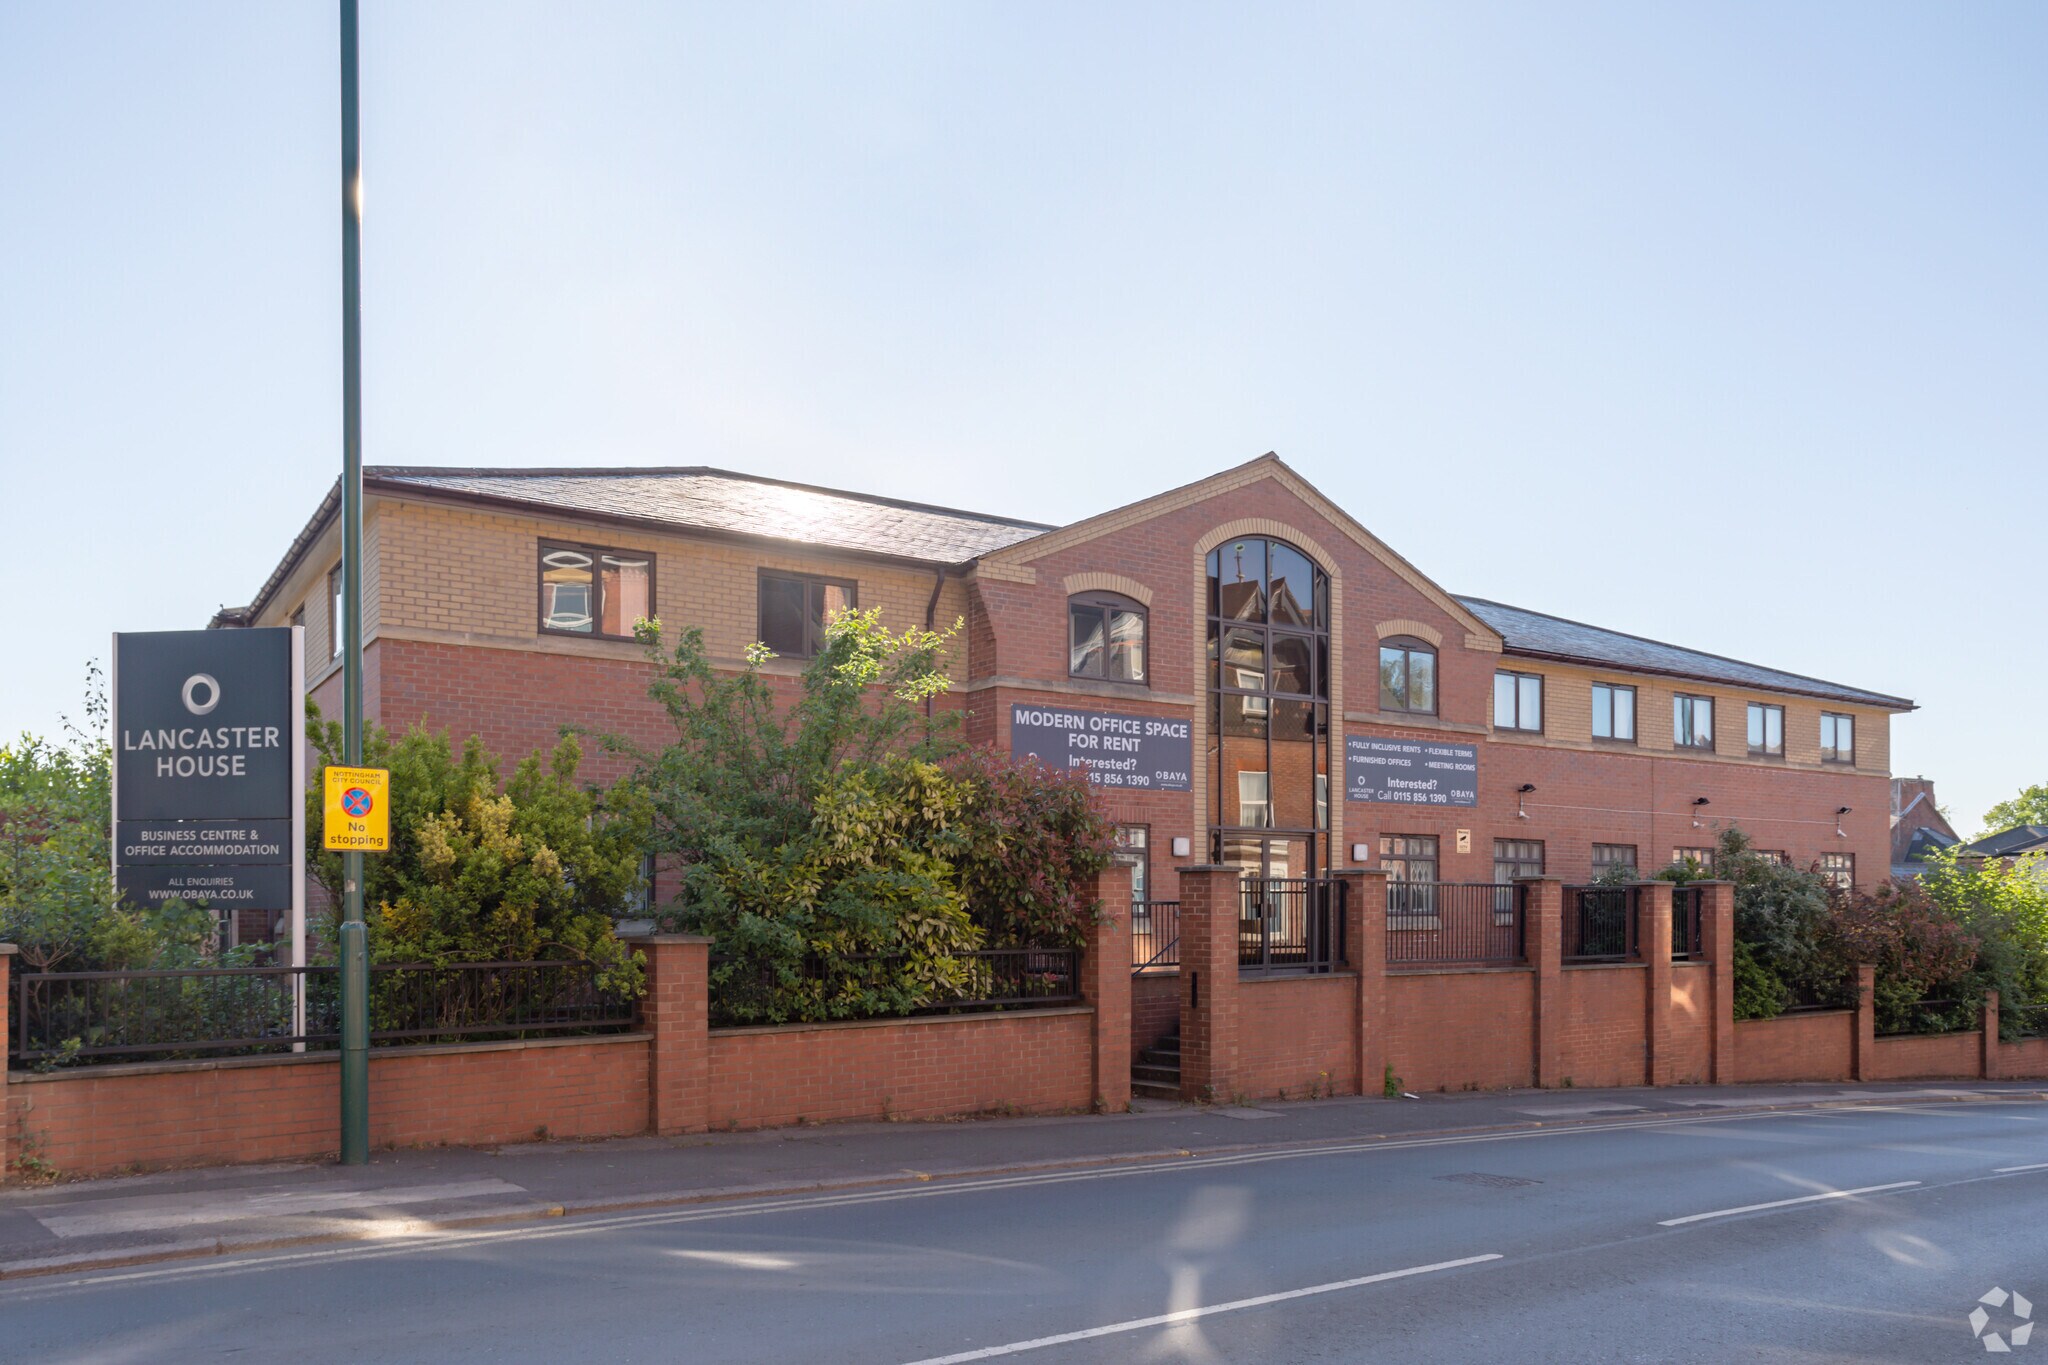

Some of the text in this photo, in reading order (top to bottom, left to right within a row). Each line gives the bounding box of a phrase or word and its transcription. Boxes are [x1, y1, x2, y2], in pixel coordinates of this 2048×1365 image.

[1016, 710, 1187, 738] MODERN OFFICE SPACE
[125, 727, 279, 751] LANCASTER
[1069, 734, 1141, 752] FOR RENT
[1371, 743, 1401, 752] INCLUSIVE
[1402, 746, 1421, 754] RENTS
[1429, 748, 1453, 756] FLEXIBLE
[157, 755, 245, 777] HOUSE
[1353, 756, 1411, 767] FURNISHED OFFICES
[1455, 763, 1475, 771] ROOMS
[1104, 774, 1122, 784] 856
[1127, 775, 1149, 786] 1390
[1156, 771, 1187, 781] OBAYA
[1388, 777, 1437, 790] Interested?
[1378, 791, 1392, 800] Call
[1393, 792, 1411, 801] 0115
[1413, 794, 1427, 802] 856
[1429, 794, 1446, 803] 1390
[1451, 790, 1474, 798] OBAYA
[348, 822, 365, 831] No
[141, 830, 258, 841] BUSINESS CENTRE &
[331, 835, 383, 846] stopping
[125, 845, 279, 856] OFFICE ACCOMMODATION
[168, 878, 234, 886] ALL ENQUIRIES
[149, 890, 254, 899] WWW.OBAYA.CO.UK
